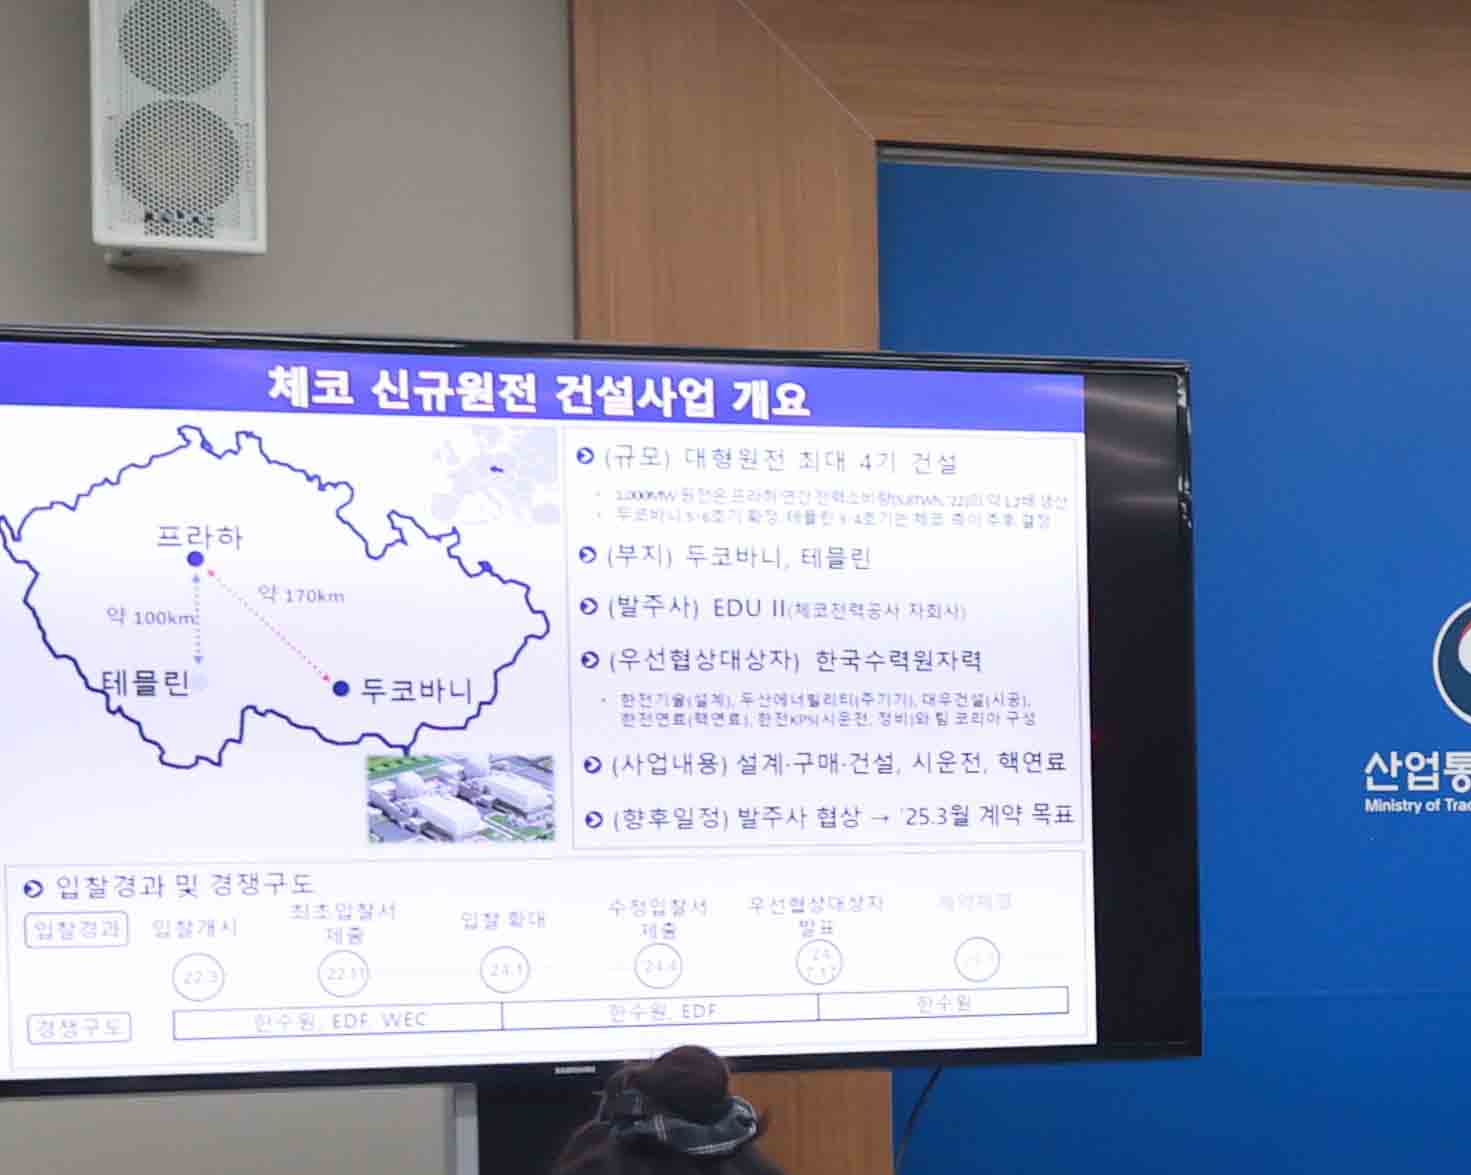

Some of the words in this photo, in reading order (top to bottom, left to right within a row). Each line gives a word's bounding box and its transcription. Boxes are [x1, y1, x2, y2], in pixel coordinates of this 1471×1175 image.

[268, 366, 354, 408] 체코
[373, 371, 537, 415] 신규원전
[557, 375, 715, 418] 건설사업
[733, 381, 811, 421] 개요
[604, 445, 671, 471] (규모)
[684, 447, 786, 472] 대형원전
[799, 449, 846, 473] 최대
[912, 450, 957, 476] 건설
[157, 527, 243, 550] 프라하
[607, 544, 672, 571] (부지)
[800, 547, 872, 572] 테믈린
[258, 584, 279, 605] 약
[286, 588, 345, 604] 170km
[608, 593, 699, 620] (발주사)
[714, 599, 761, 618] EDU
[106, 606, 127, 626] 약
[609, 648, 800, 673] (우선협상대상자)
[816, 649, 982, 672] 한국수력원자력
[102, 670, 190, 697] 테믈린
[362, 678, 473, 706] 두코바니
[612, 751, 727, 776] (사업내용)
[998, 751, 1067, 773] 핵연료
[613, 808, 728, 832] (향후일정)
[737, 807, 808, 830] 발주사
[816, 807, 860, 829] 협상
[979, 804, 1023, 827] 계약
[1032, 803, 1075, 825] 목표
[1365, 798, 1421, 814] Ministry
[1426, 798, 1440, 812] of
[56, 875, 165, 900] 입찰경과
[176, 875, 200, 898] 및
[210, 873, 315, 897] 경쟁구도
[34, 918, 122, 941] 입찰경과
[382, 1010, 426, 1027] WEC
[682, 1004, 717, 1019] EDF
